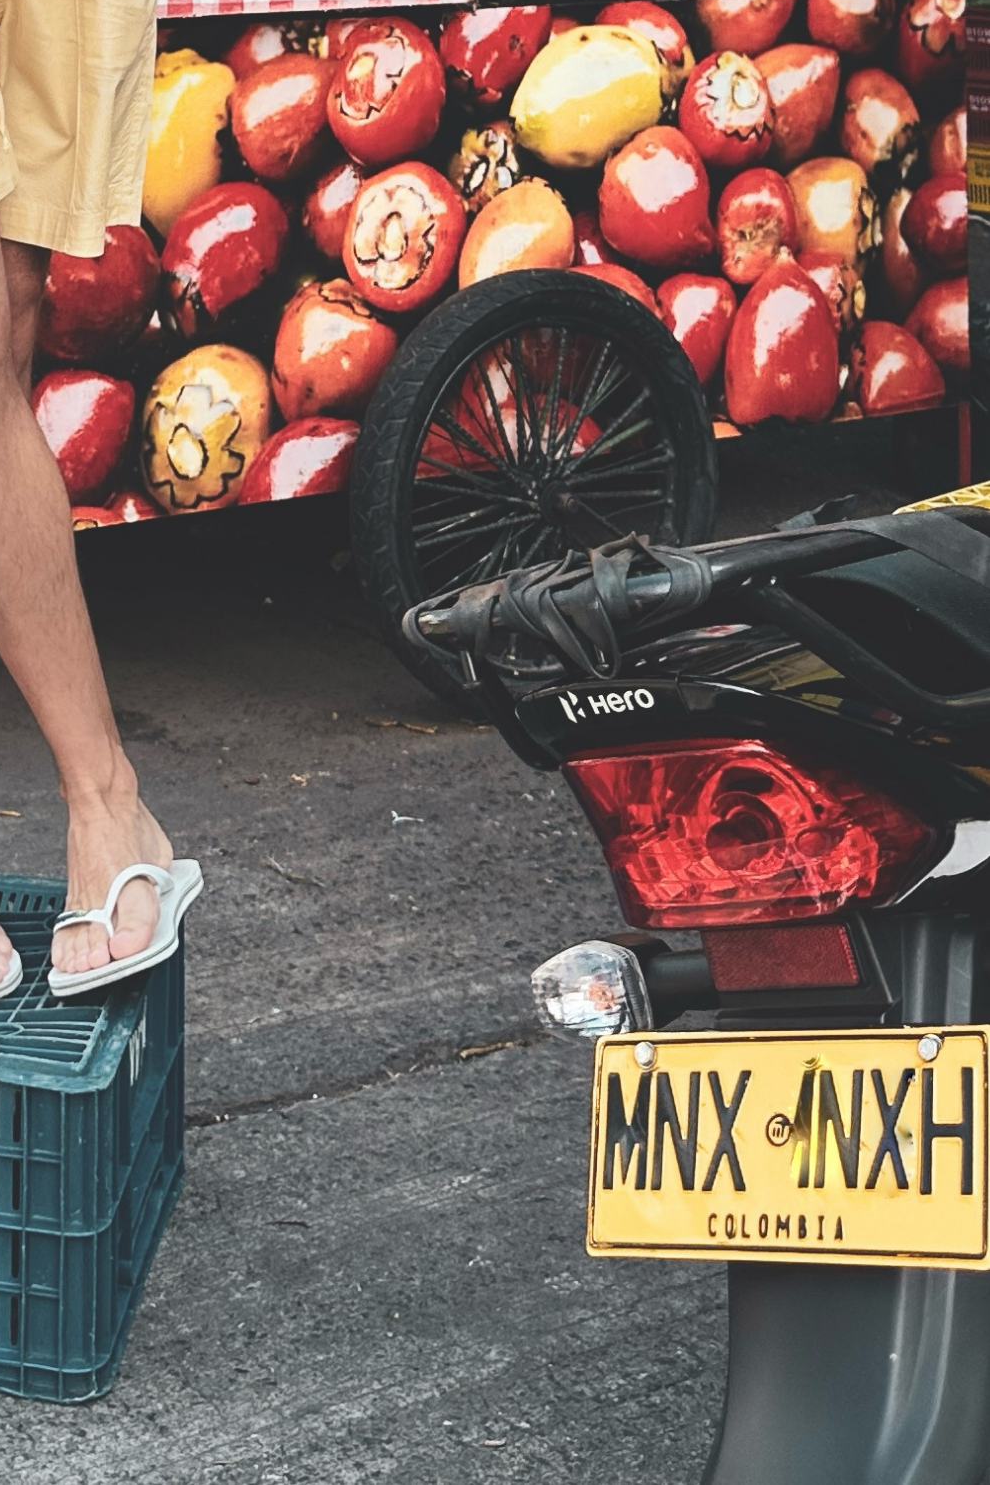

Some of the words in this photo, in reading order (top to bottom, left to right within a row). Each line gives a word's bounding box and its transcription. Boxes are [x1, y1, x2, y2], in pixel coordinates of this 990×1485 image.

[587, 688, 655, 715] Hero
[602, 1070, 752, 1191] MNX
[708, 1213, 844, 1241] COLOMBIA
